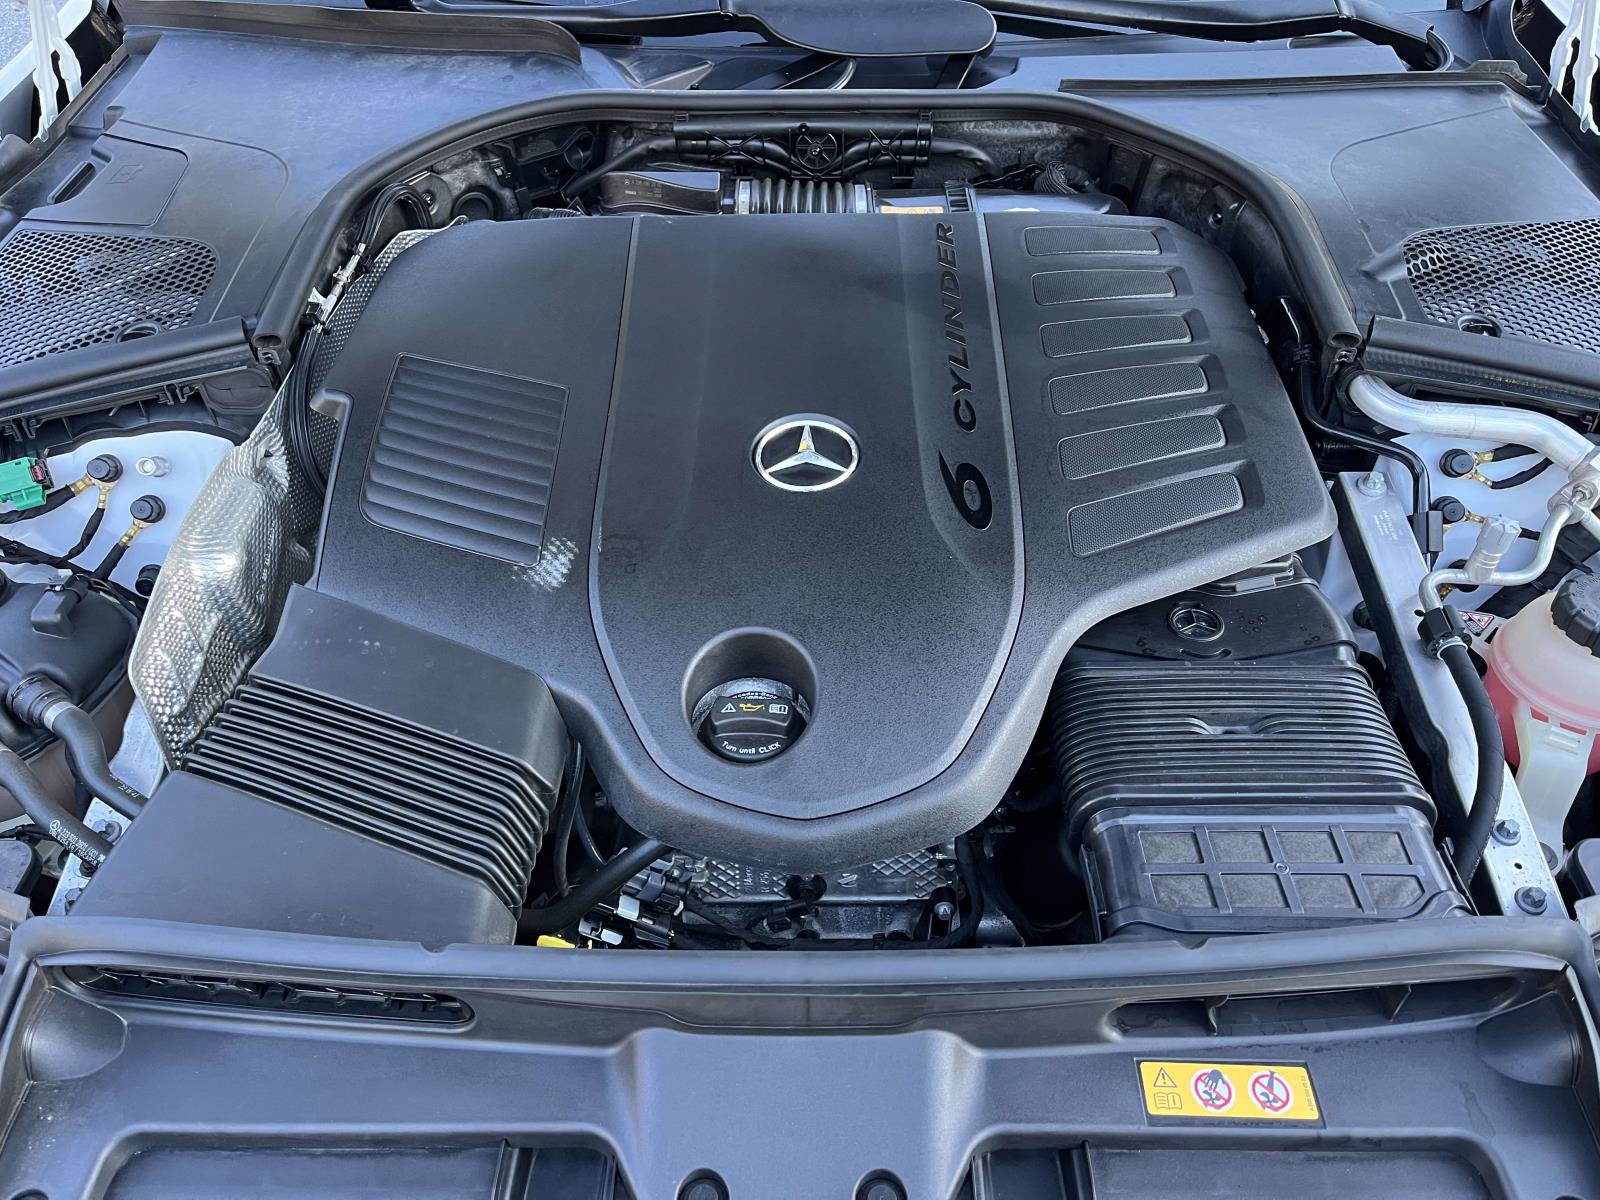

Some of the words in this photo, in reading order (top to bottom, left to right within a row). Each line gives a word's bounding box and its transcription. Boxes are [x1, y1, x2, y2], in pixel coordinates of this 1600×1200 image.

[936, 222, 977, 433] CYLINDER
[938, 449, 993, 531] 6
[722, 740, 737, 752] Turn
[758, 741, 781, 754] CLICK
